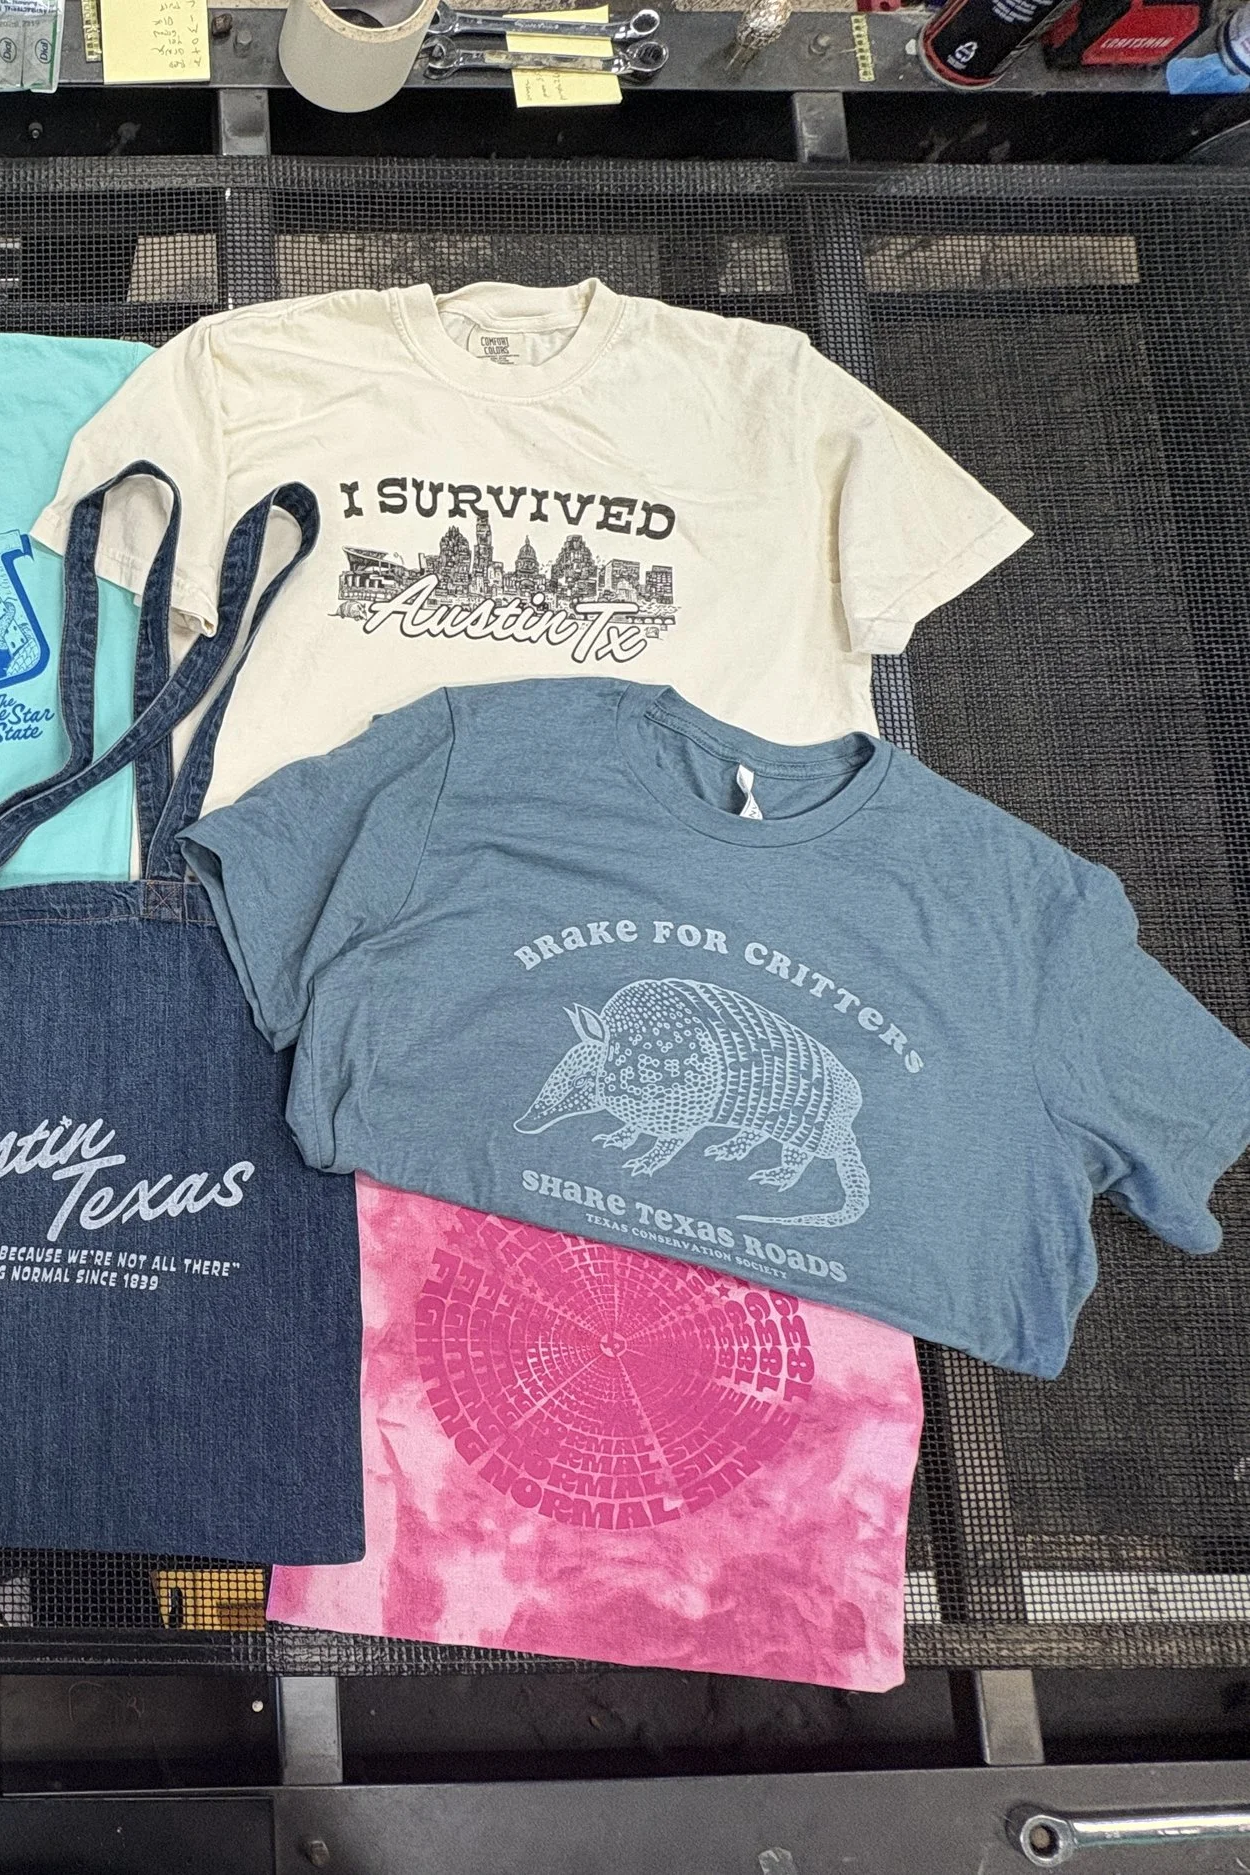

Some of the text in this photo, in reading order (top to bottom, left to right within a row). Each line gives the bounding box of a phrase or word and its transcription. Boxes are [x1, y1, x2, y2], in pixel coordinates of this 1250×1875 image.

[3, 41, 12, 60] Dial
[40, 42, 48, 60] Dial
[1100, 36, 1175, 49] CRAFTSMAN
[484, 346, 510, 354] COLORS
[340, 476, 676, 540] I SURVIVED
[362, 572, 648, 664] Austin Tx
[7, 699, 56, 724] Star
[653, 920, 729, 955] FOR
[47, 1154, 255, 1242] Texas
[0, 1246, 62, 1263] BECAUSE
[68, 1248, 113, 1267] WE'RE
[117, 1252, 146, 1270] NOT
[152, 1255, 177, 1272] ALL
[585, 1213, 628, 1233] TEXAS
[631, 1227, 732, 1262] CONSERVATION
[736, 1255, 787, 1280] SOCIETY
[11, 1266, 70, 1283] NORMAL
[76, 1269, 117, 1287] SINCE
[124, 1273, 159, 1290] 1839
[724, 1301, 756, 1384] 1839
[745, 1292, 782, 1392] 1839
[416, 1247, 489, 1465] FIGHTING
[477, 1454, 681, 1529] NORMAL
[768, 1291, 813, 1404] 1839
